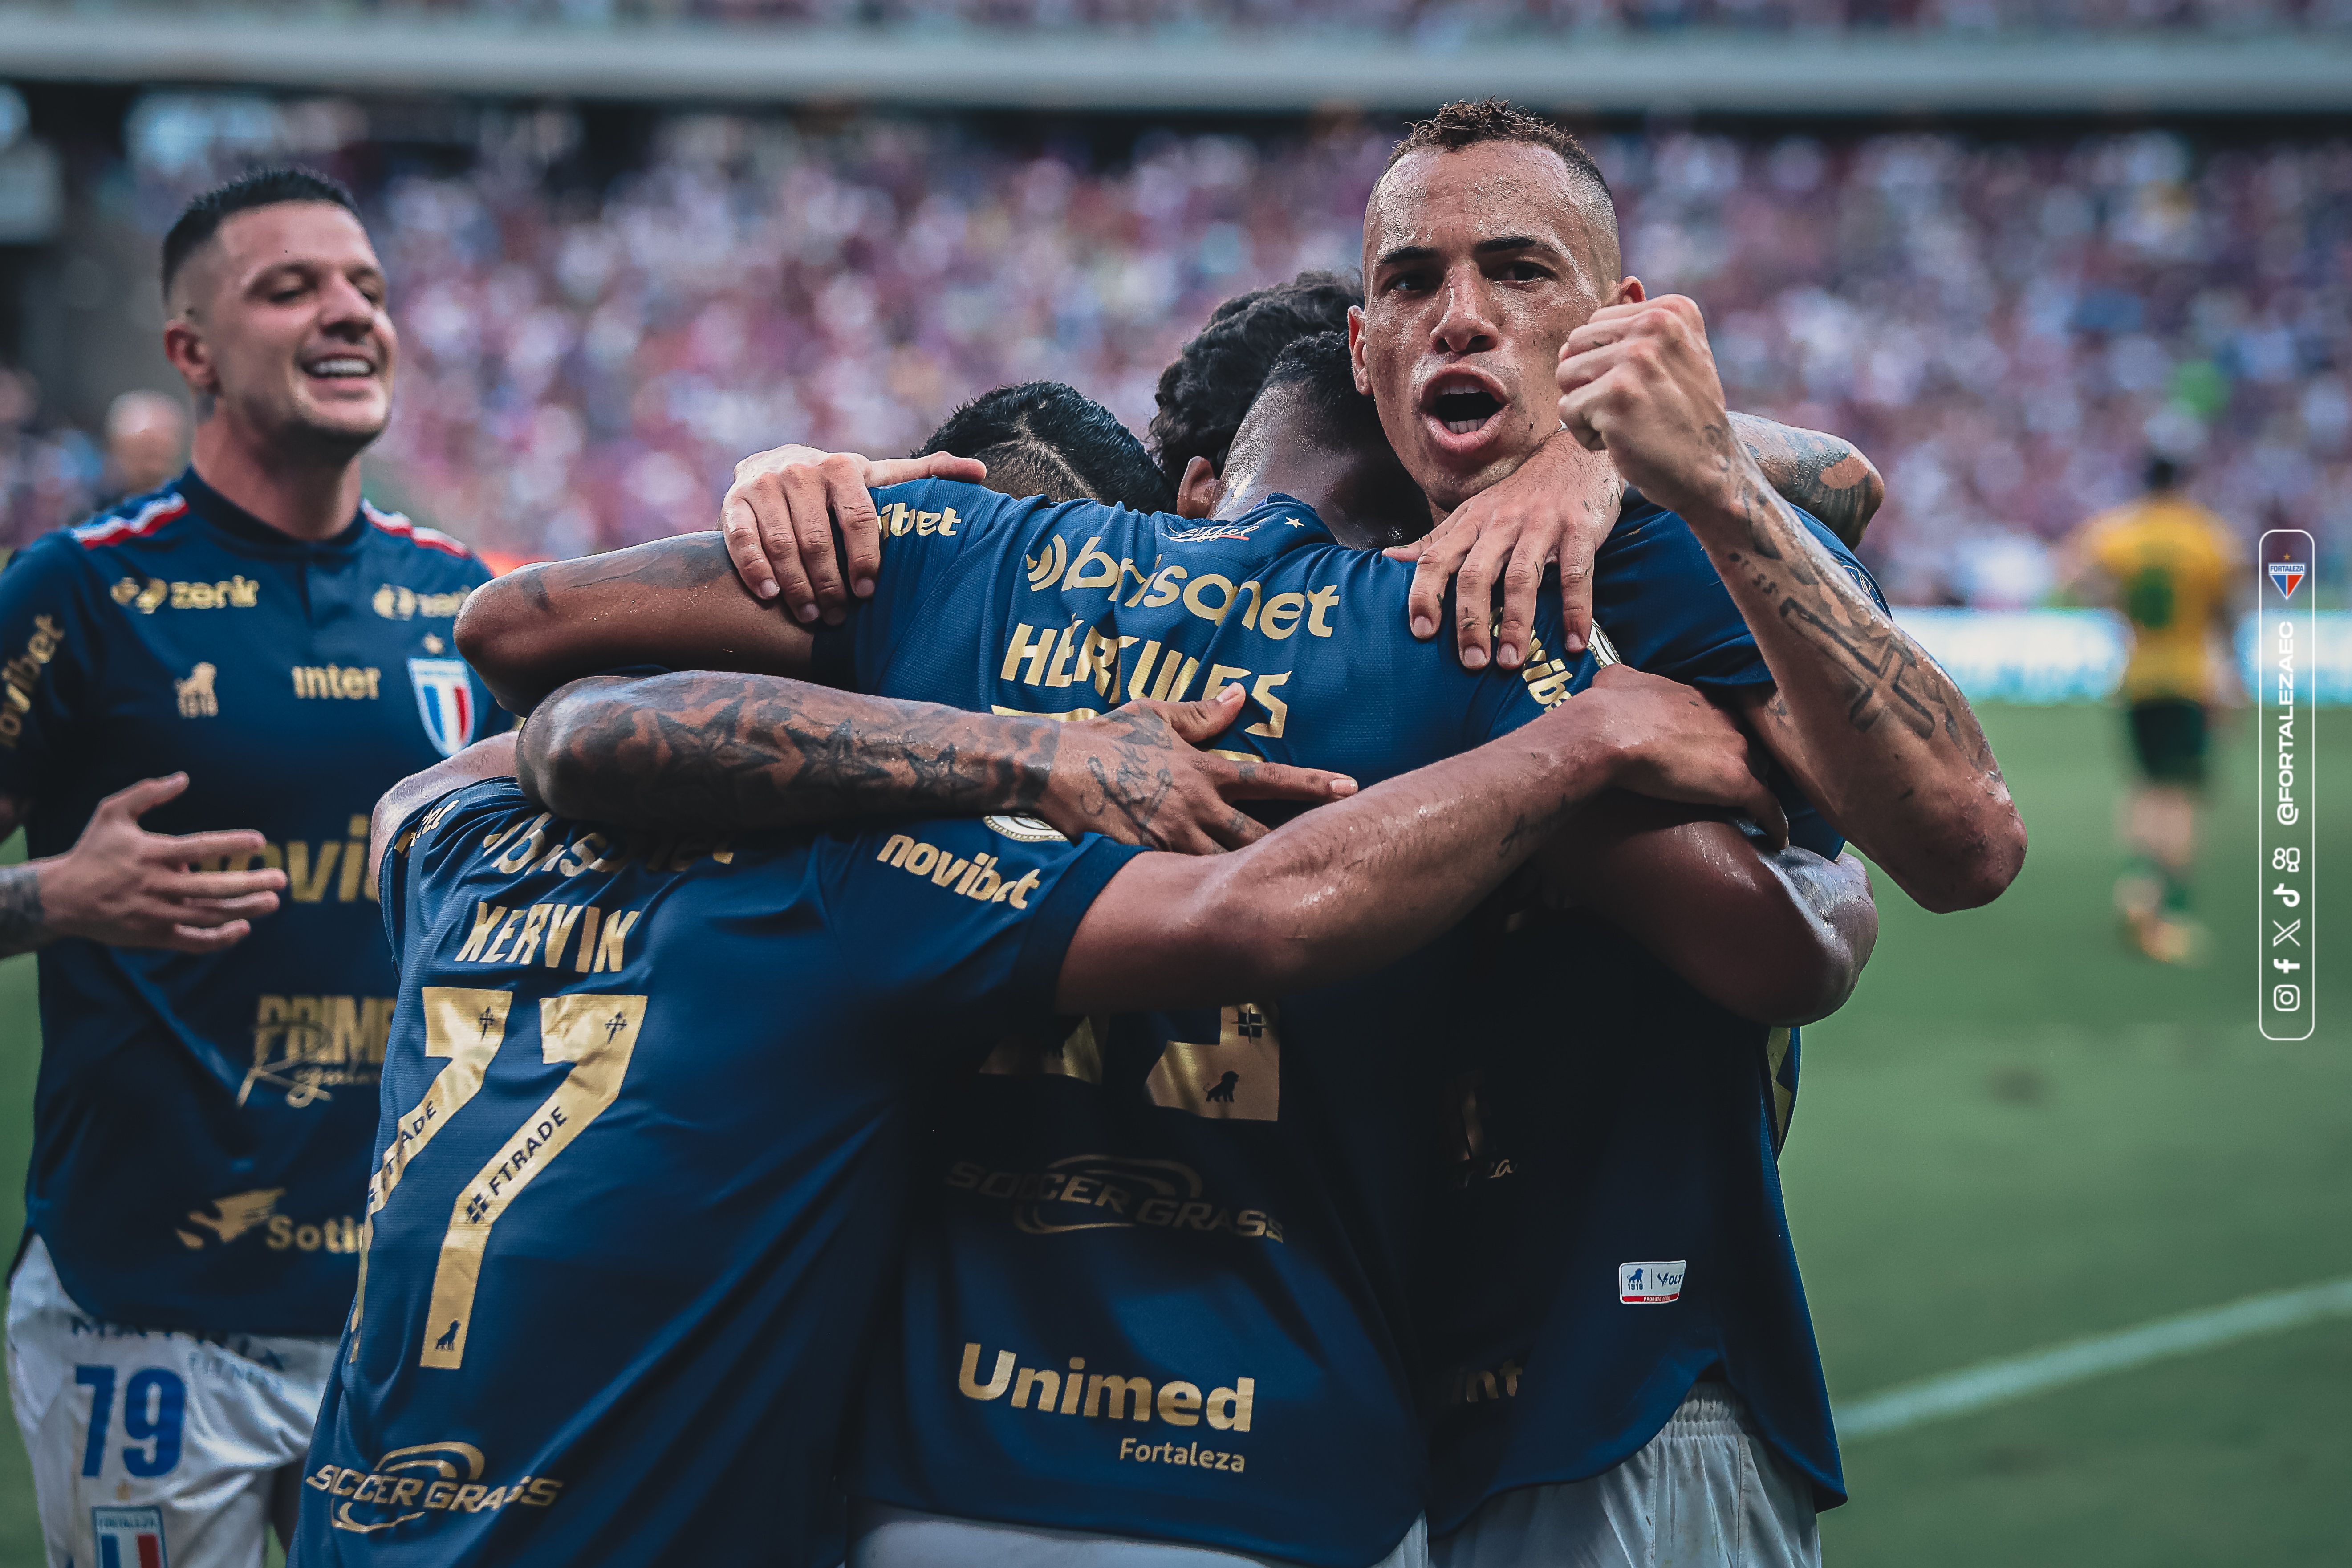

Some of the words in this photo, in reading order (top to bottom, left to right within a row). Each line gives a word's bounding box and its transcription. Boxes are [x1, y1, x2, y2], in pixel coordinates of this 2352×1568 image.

[877, 503, 962, 540] ibet
[454, 902, 640, 973] KERVIN
[354, 987, 648, 1369] 77
[490, 1106, 568, 1196] FTRADE
[75, 1364, 186, 1478] 79
[959, 1342, 1255, 1432] Unimed
[1119, 1437, 1246, 1473] Fortaleza
